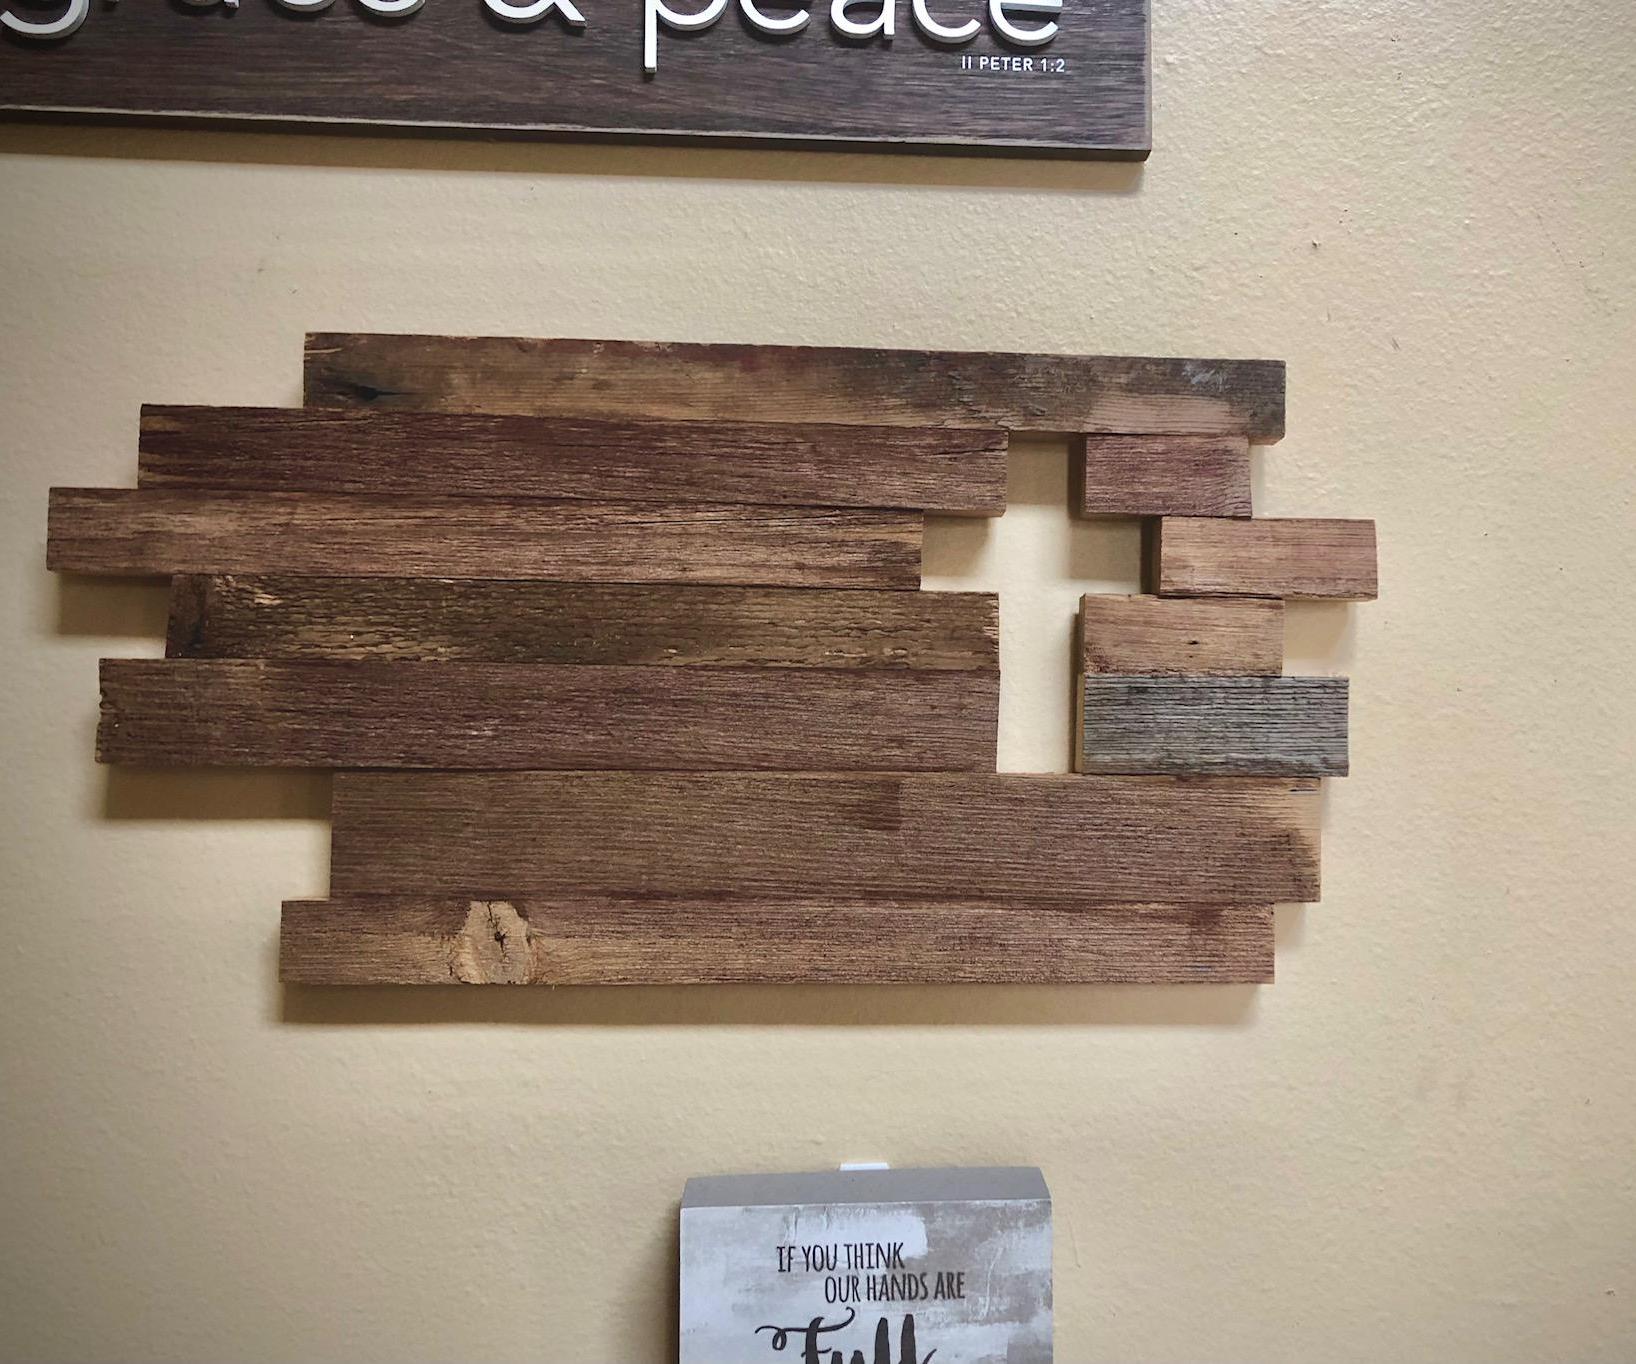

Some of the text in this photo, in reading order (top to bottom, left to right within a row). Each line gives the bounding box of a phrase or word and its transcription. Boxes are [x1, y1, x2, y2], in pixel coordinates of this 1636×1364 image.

[961, 55, 1065, 72] II PETER 1:2
[776, 1242, 905, 1273] IF YOU THINK
[824, 1271, 966, 1304] OUR HANDS ARE
